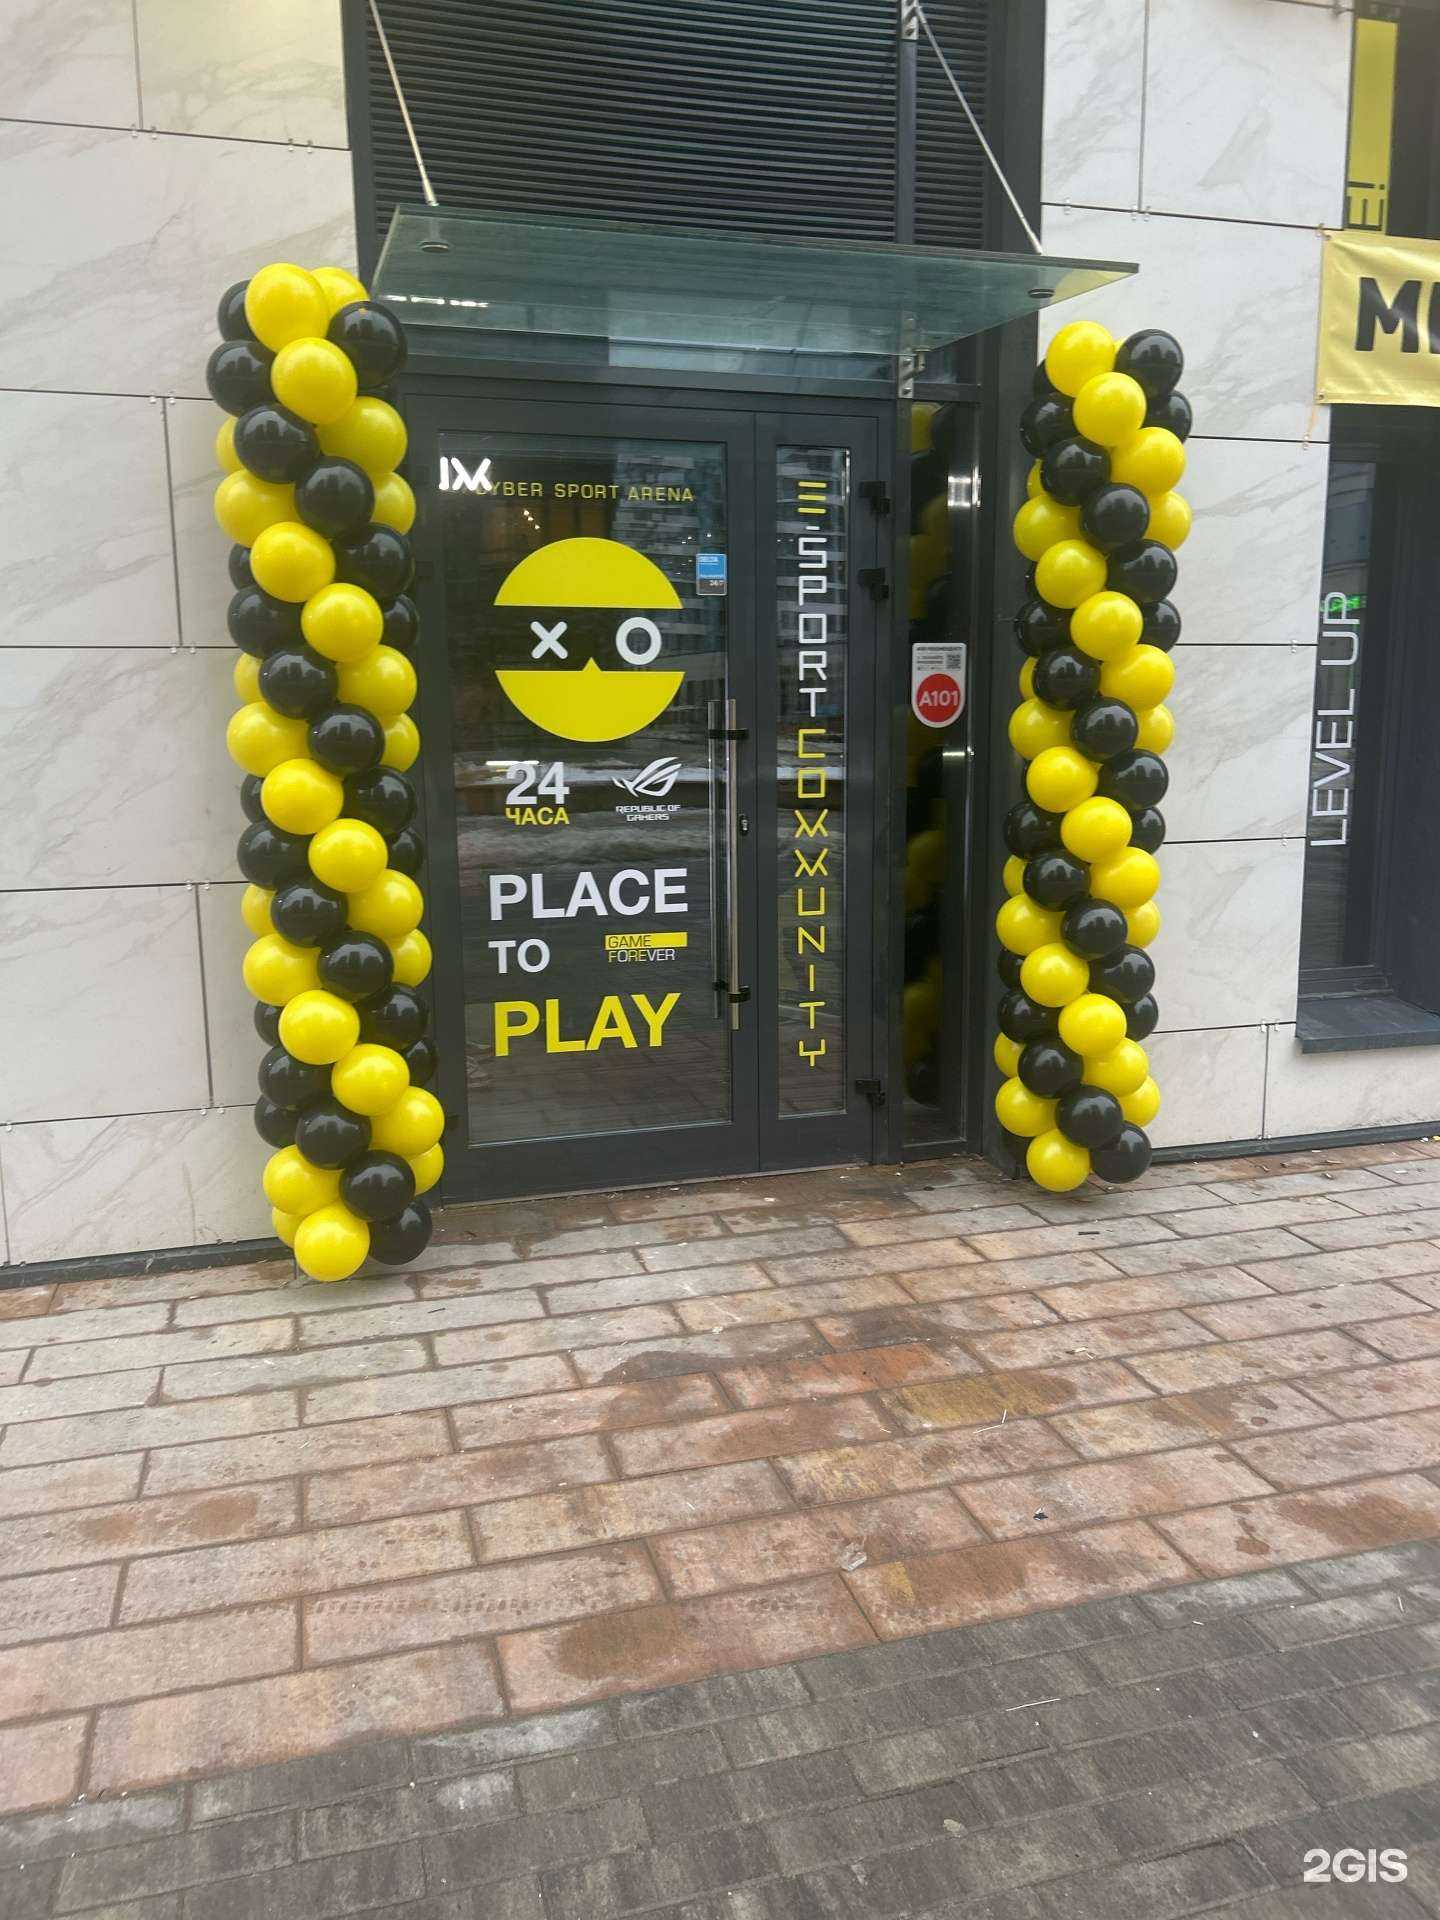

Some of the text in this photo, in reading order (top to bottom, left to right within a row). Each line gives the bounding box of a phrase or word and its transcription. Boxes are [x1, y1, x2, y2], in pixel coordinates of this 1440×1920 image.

[476, 481, 694, 502] YBER SPORT ARENA
[919, 690, 960, 707] A101
[1310, 591, 1361, 847] LEVEL UP
[505, 761, 570, 805] 24
[505, 806, 570, 826] ЧАСА
[616, 804, 681, 814] REPUBLIC OF
[626, 813, 670, 822] GAMERS
[488, 868, 688, 921] PLACE
[794, 728, 829, 1067] COMMUNITY
[607, 935, 652, 949] GAME
[488, 938, 551, 974] TO
[608, 948, 676, 963] FOREVER
[494, 992, 681, 1057] PLAY
